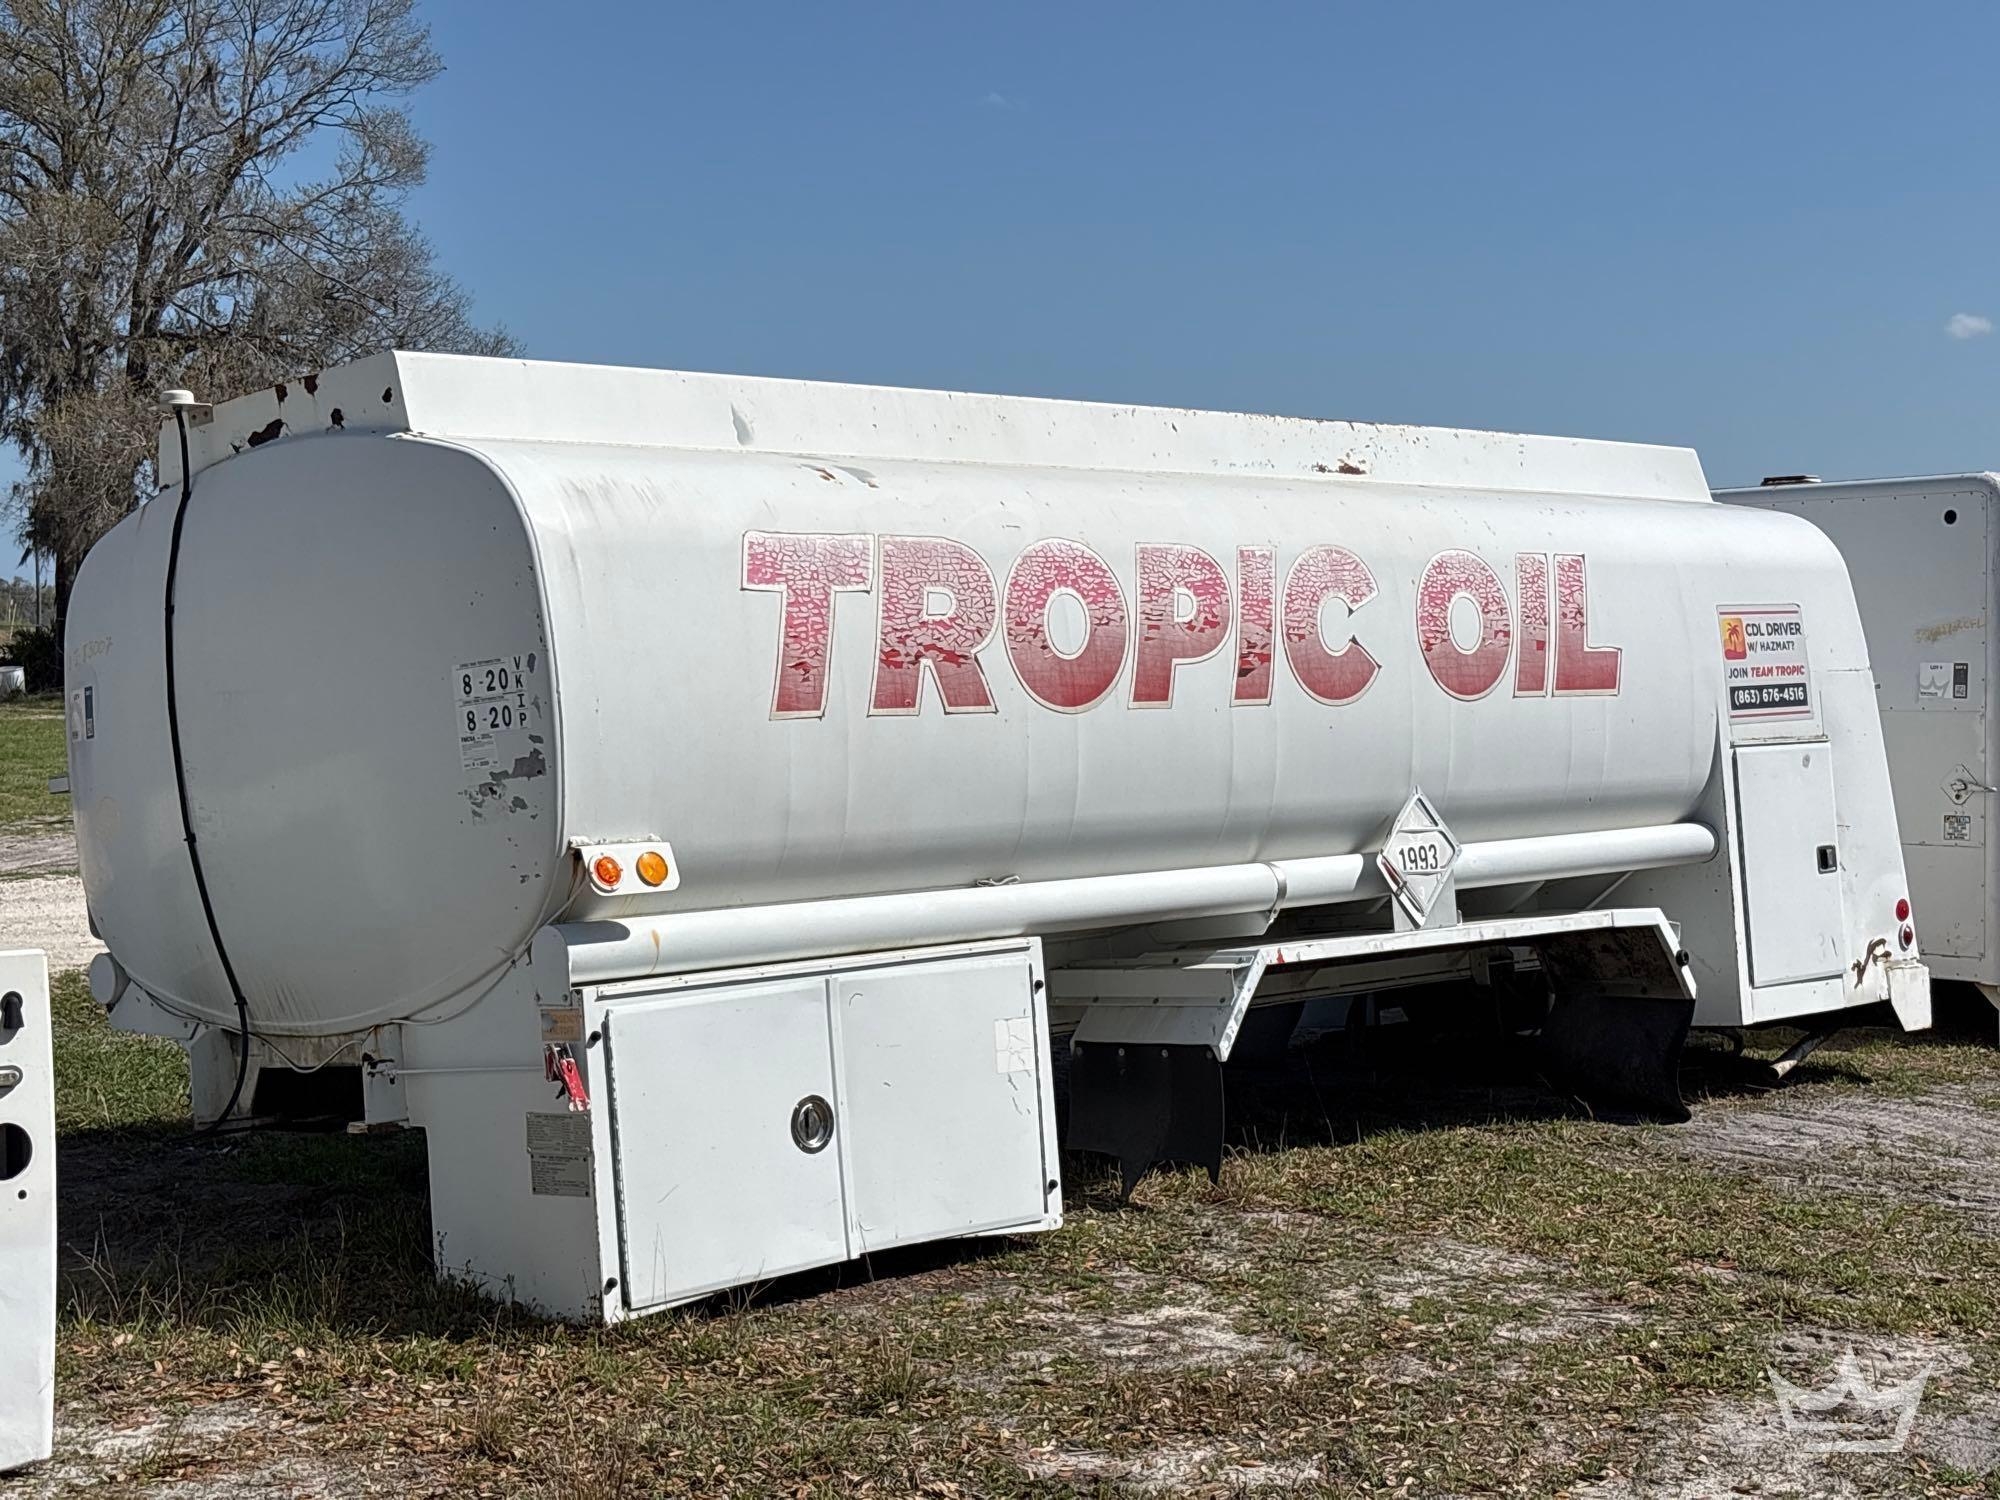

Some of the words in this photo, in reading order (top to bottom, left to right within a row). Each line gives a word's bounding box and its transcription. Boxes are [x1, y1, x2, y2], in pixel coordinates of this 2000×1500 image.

[742, 531, 1381, 720] TROPIC
[1415, 548, 1622, 700] OIL
[1745, 623, 1765, 637] CDL
[1766, 622, 1802, 636] DRIVER
[1747, 642, 1758, 653] W/
[1760, 640, 1795, 652] HAZMAT?
[1728, 667, 1748, 679] JOIN
[1750, 666, 1774, 678] TEAM
[1775, 665, 1805, 677] TROPIC
[1734, 689, 1760, 706] (863)
[1762, 687, 1804, 702] 676-4516
[1398, 843, 1439, 871] 1993
